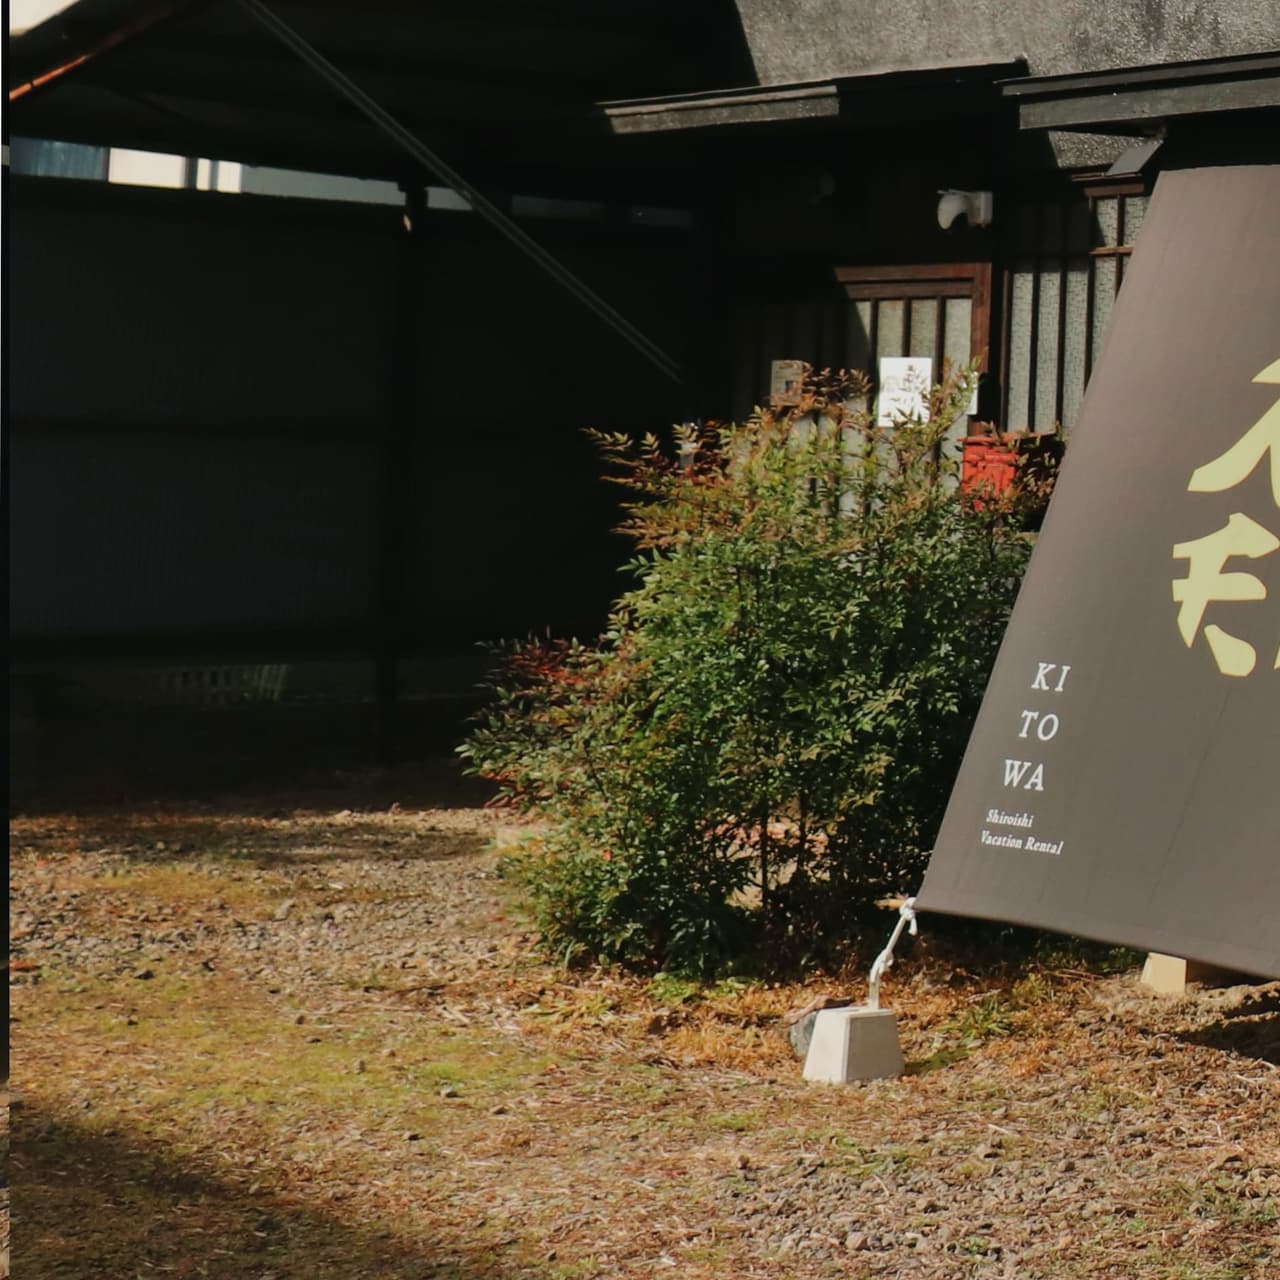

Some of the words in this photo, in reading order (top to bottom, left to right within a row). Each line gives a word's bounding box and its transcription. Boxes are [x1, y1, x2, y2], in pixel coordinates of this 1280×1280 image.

[1031, 662, 1071, 692] KI
[1019, 710, 1059, 741] TO
[1003, 759, 1045, 791] WA
[986, 809, 1034, 828] Shiroishi
[981, 830, 1023, 850] Vacation
[1024, 836, 1064, 855] Rental
